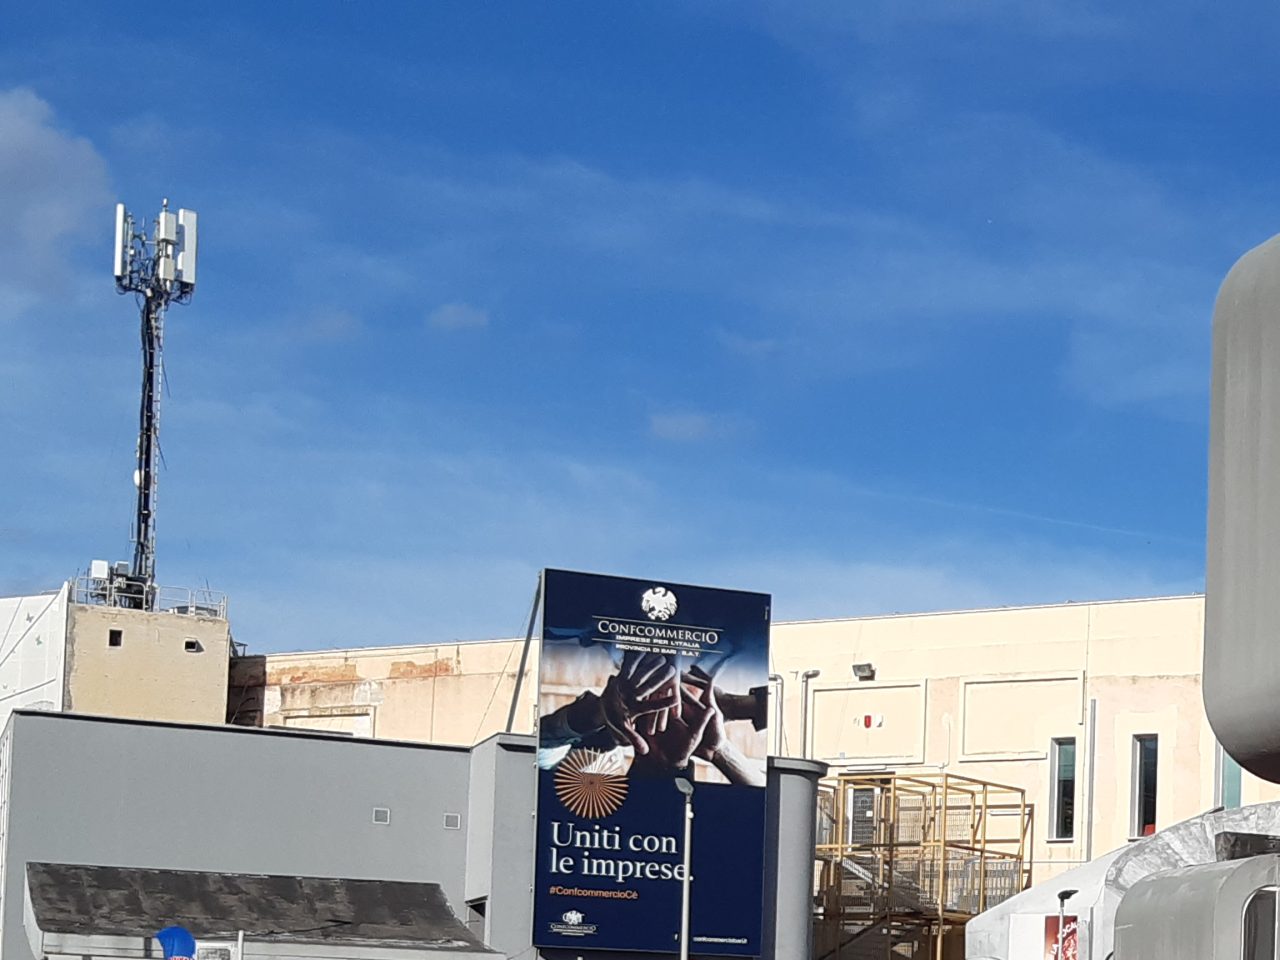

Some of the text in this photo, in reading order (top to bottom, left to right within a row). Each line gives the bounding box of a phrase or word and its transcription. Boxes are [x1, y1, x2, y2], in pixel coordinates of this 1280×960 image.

[615, 635, 651, 644] IMPRESE
[652, 638, 669, 646] PER
[615, 643, 651, 653] PROVINCIA
[551, 821, 678, 854] Uniti con
[550, 847, 694, 883] le imprese.
